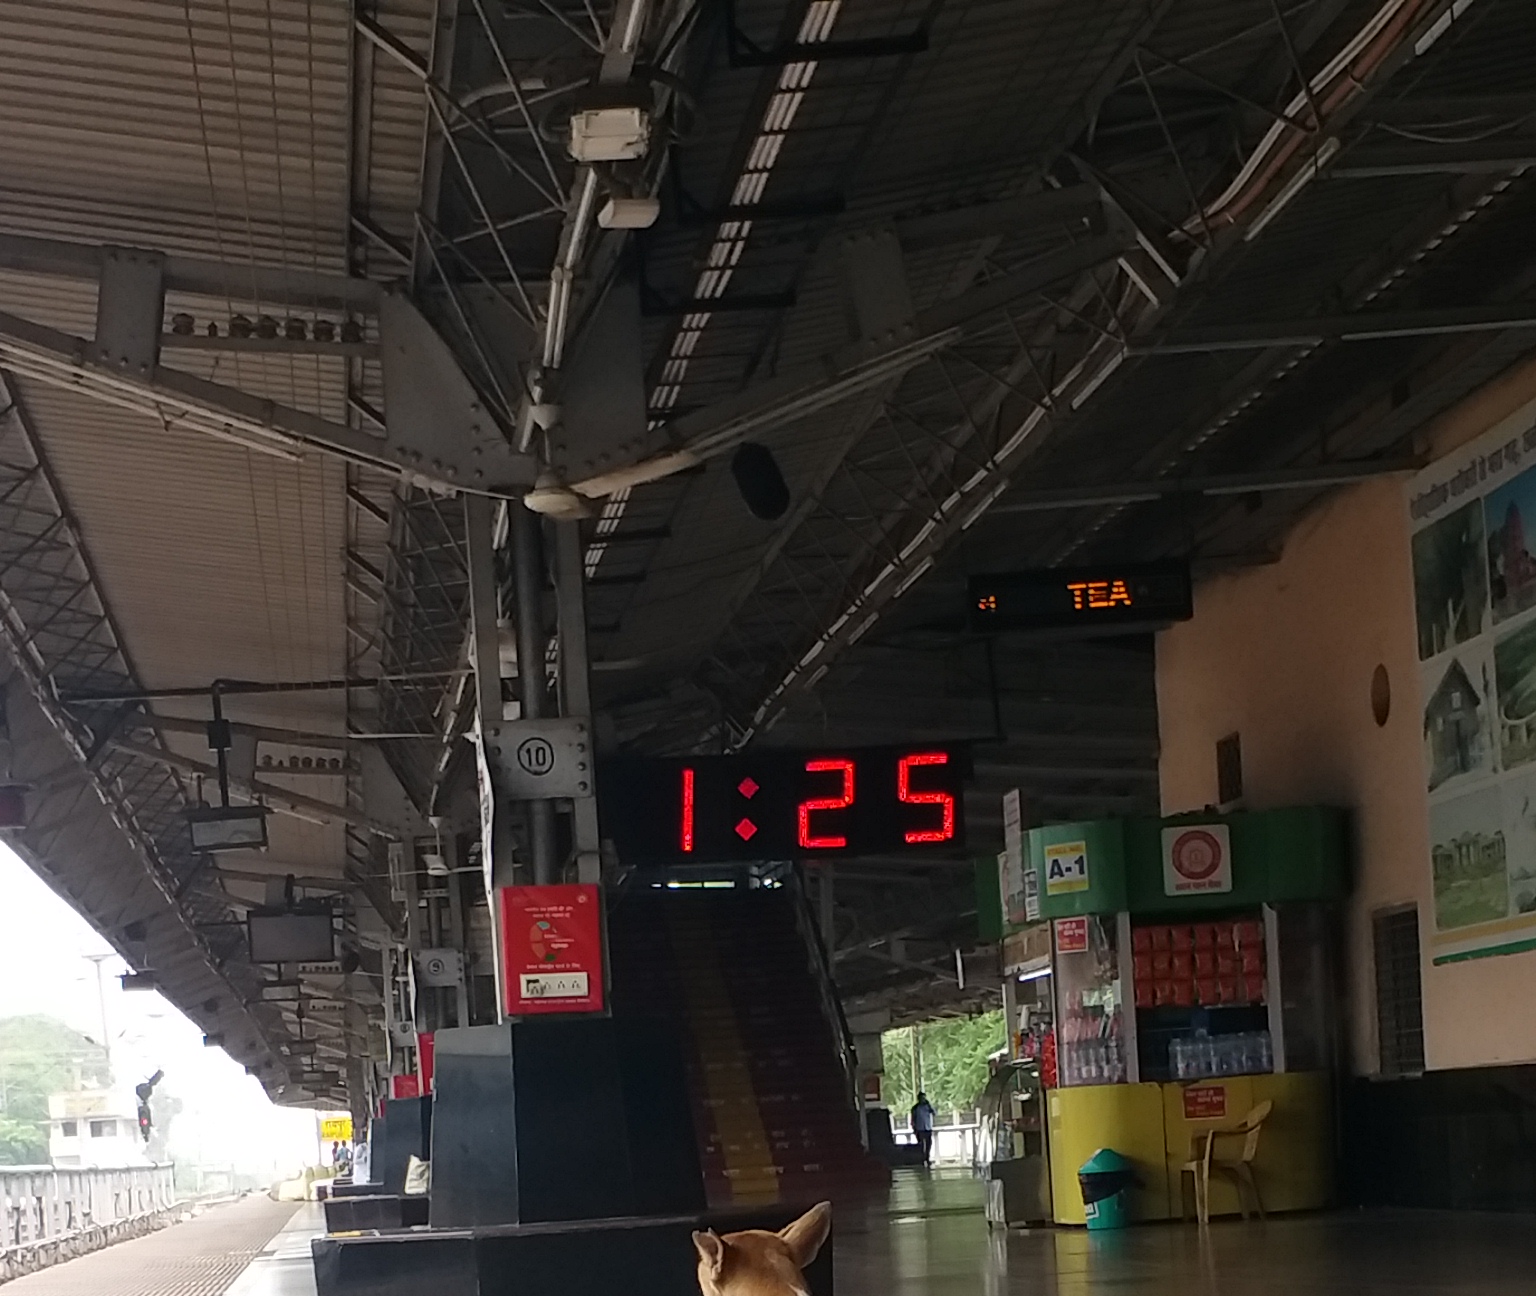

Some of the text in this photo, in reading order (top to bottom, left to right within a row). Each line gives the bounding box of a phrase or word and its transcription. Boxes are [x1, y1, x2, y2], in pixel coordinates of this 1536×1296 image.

[1067, 580, 1134, 610] TEA
[526, 746, 547, 767] 10
[680, 751, 955, 852] 1:25
[1049, 855, 1085, 879] A-1
